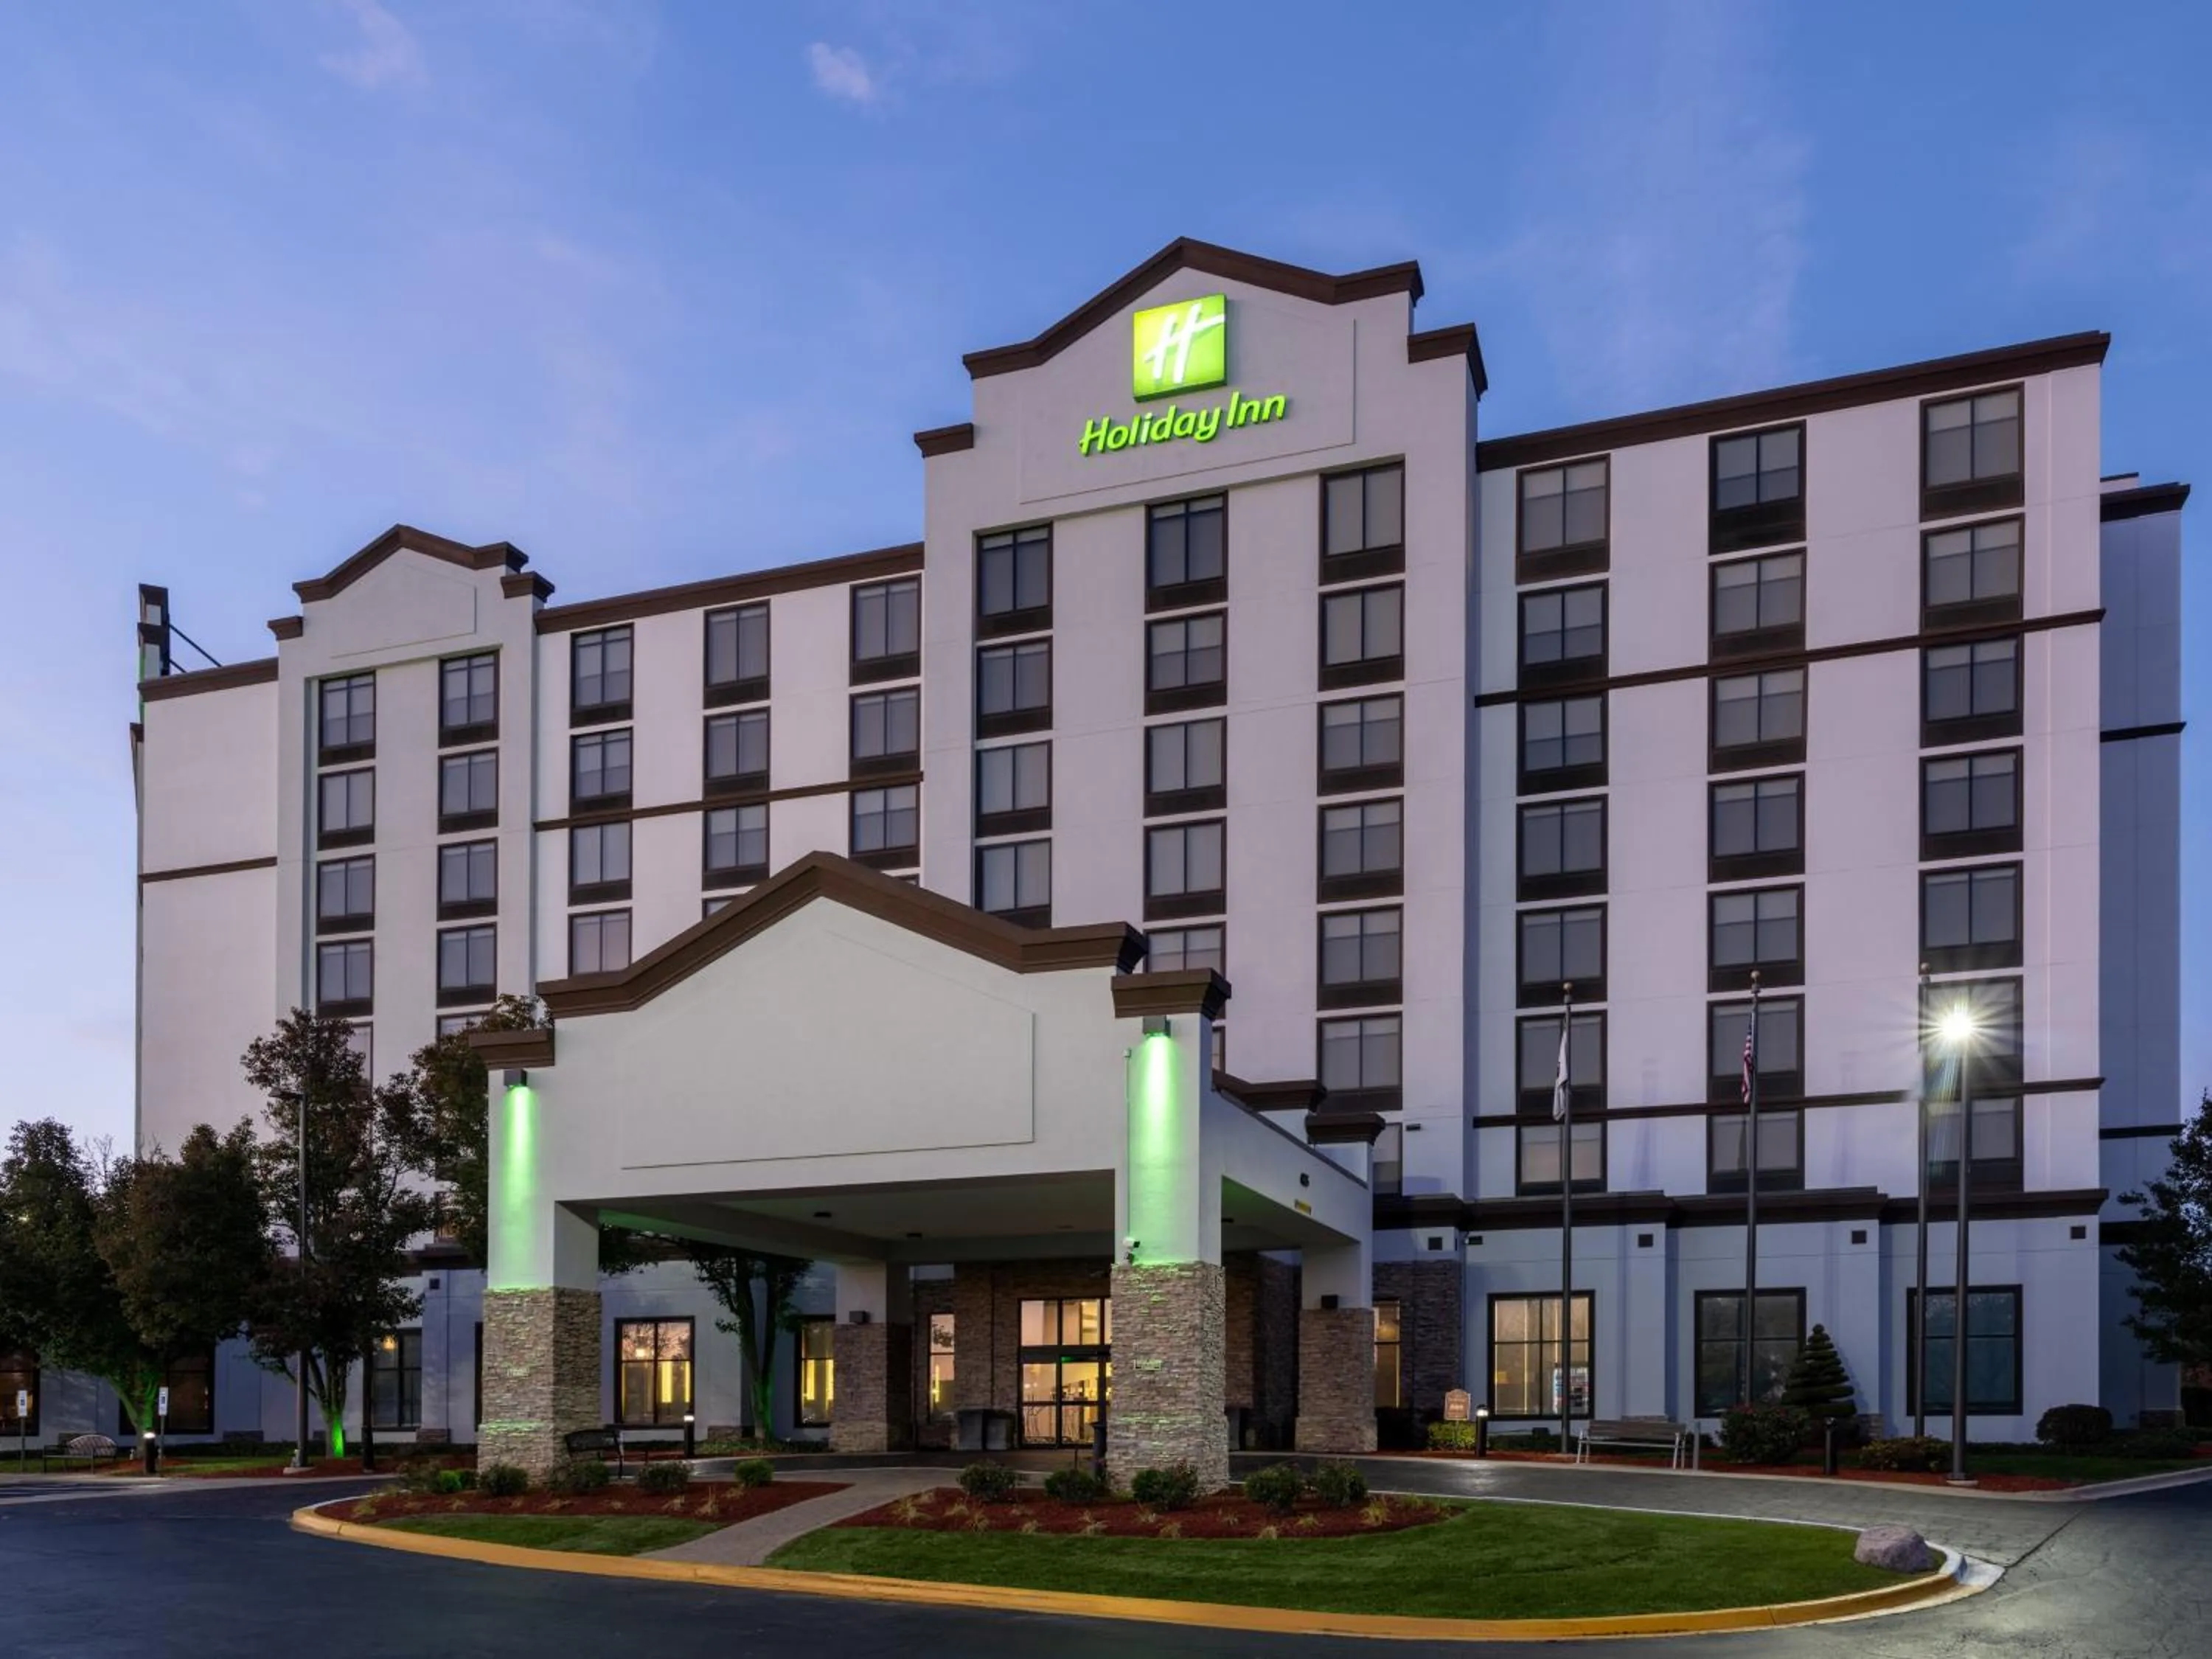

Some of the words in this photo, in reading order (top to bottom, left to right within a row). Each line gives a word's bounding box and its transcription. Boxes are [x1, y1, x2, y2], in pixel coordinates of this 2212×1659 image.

[1144, 302, 1225, 384] H
[1079, 405, 1222, 456] Holiday
[1226, 390, 1287, 428] Inn
